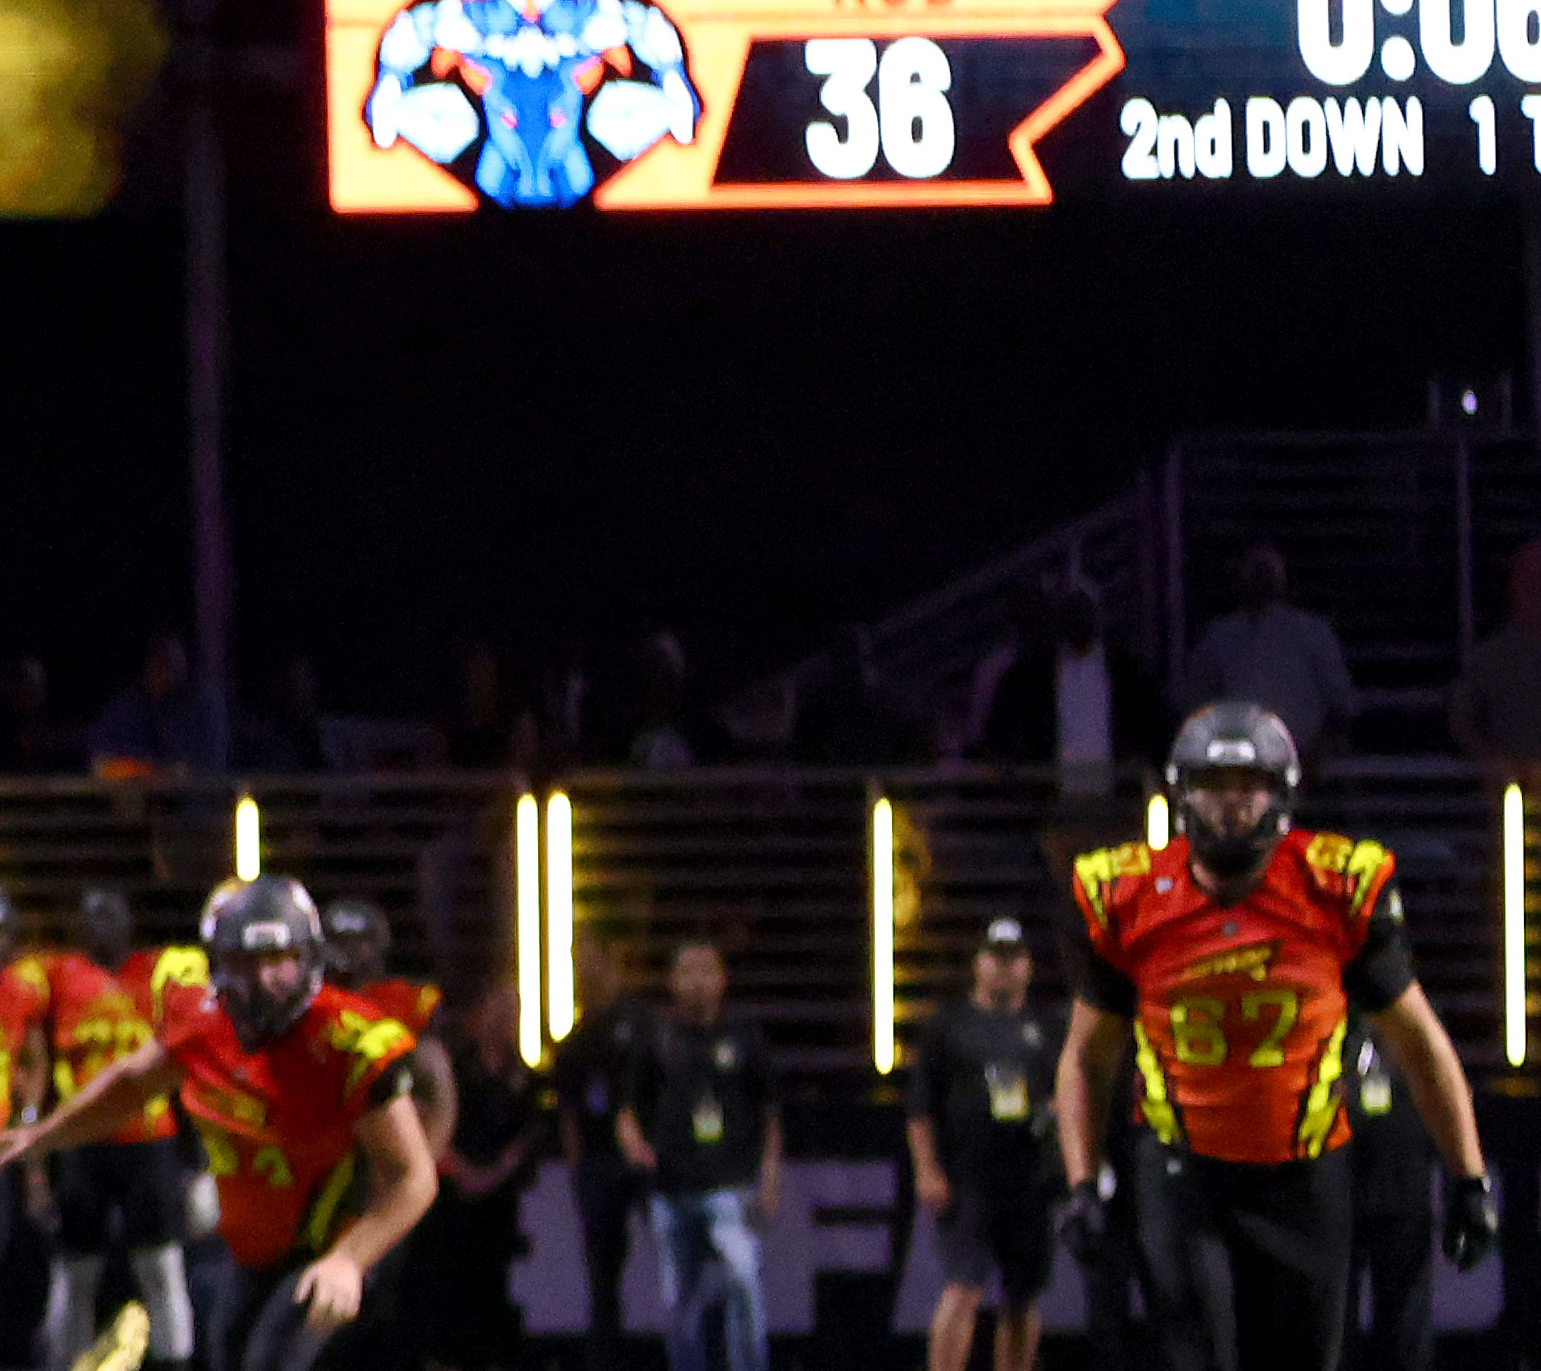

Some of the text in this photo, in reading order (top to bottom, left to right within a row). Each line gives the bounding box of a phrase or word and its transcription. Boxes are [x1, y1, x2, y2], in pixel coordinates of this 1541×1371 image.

[803, 35, 957, 179] 36
[1119, 96, 1233, 179] 2nd
[1244, 95, 1425, 178] DOWN
[1469, 95, 1497, 176] 1
